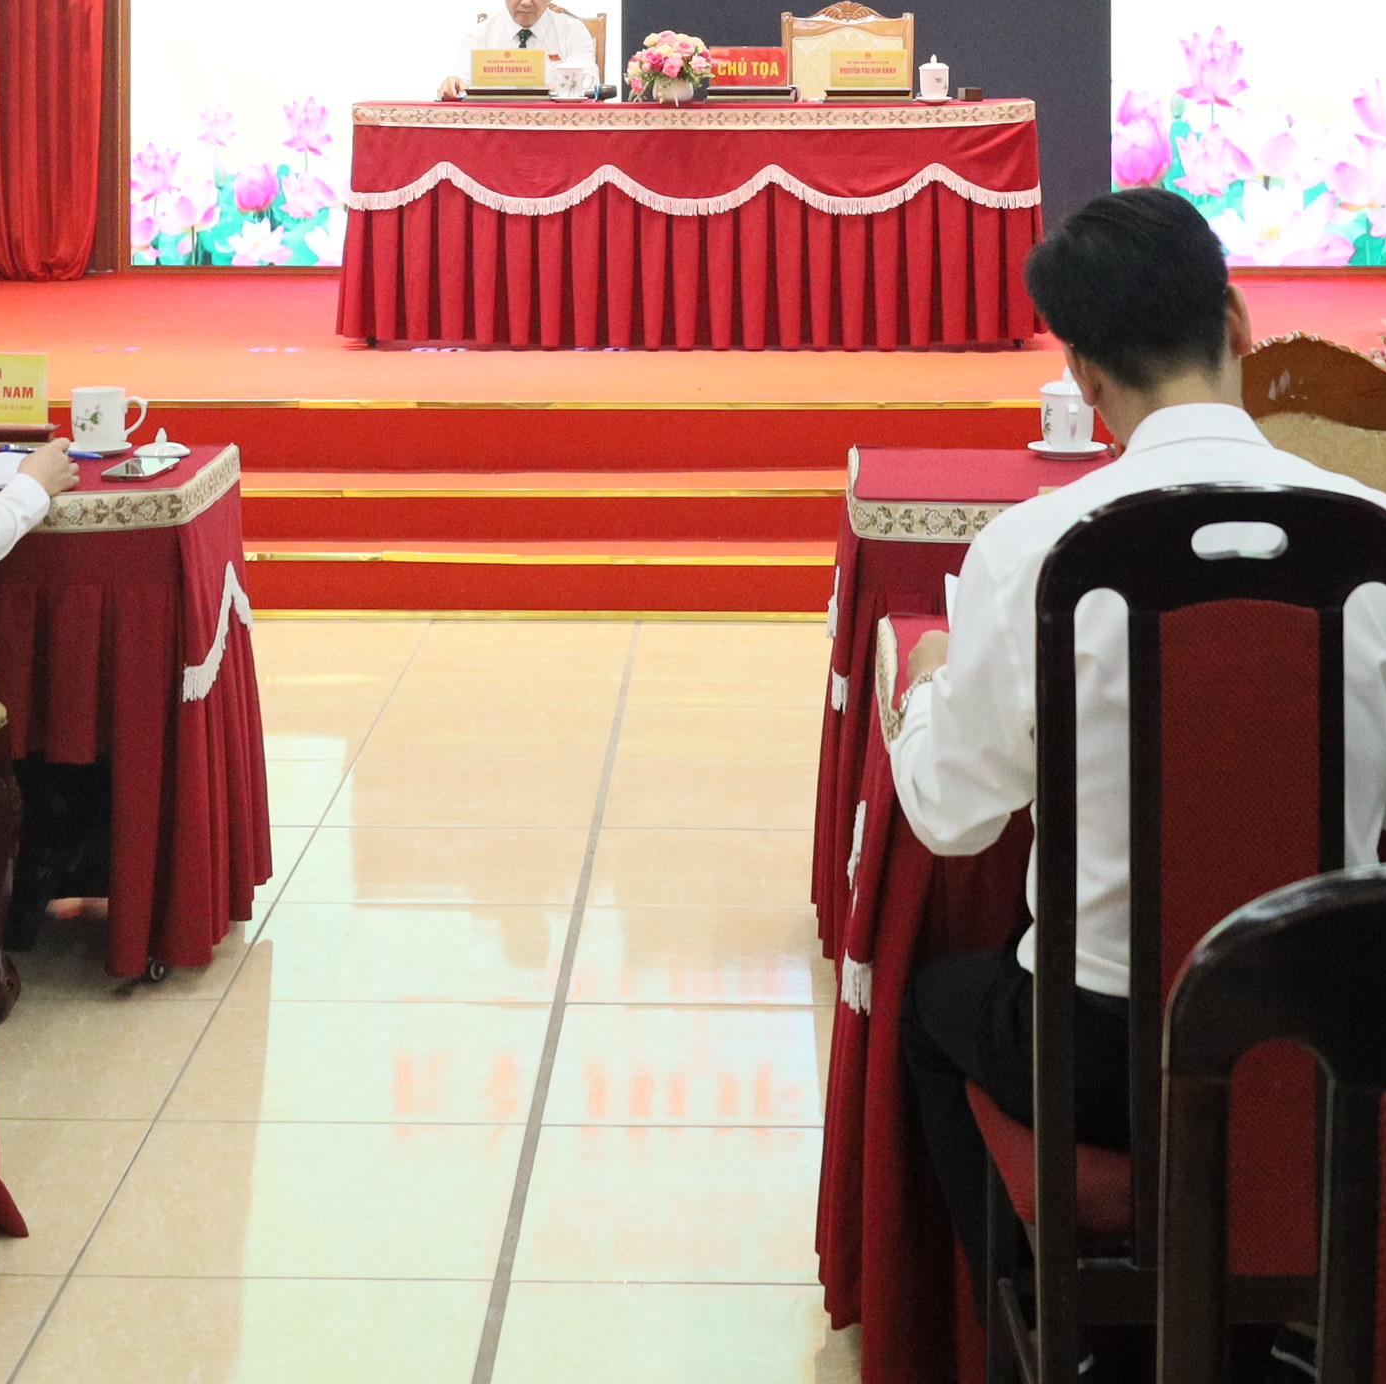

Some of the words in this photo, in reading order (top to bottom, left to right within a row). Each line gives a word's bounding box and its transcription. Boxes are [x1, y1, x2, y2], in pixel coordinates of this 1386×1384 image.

[717, 57, 748, 76] CHỦ
[751, 61, 780, 79] TỌA
[3, 386, 34, 398] NAM
